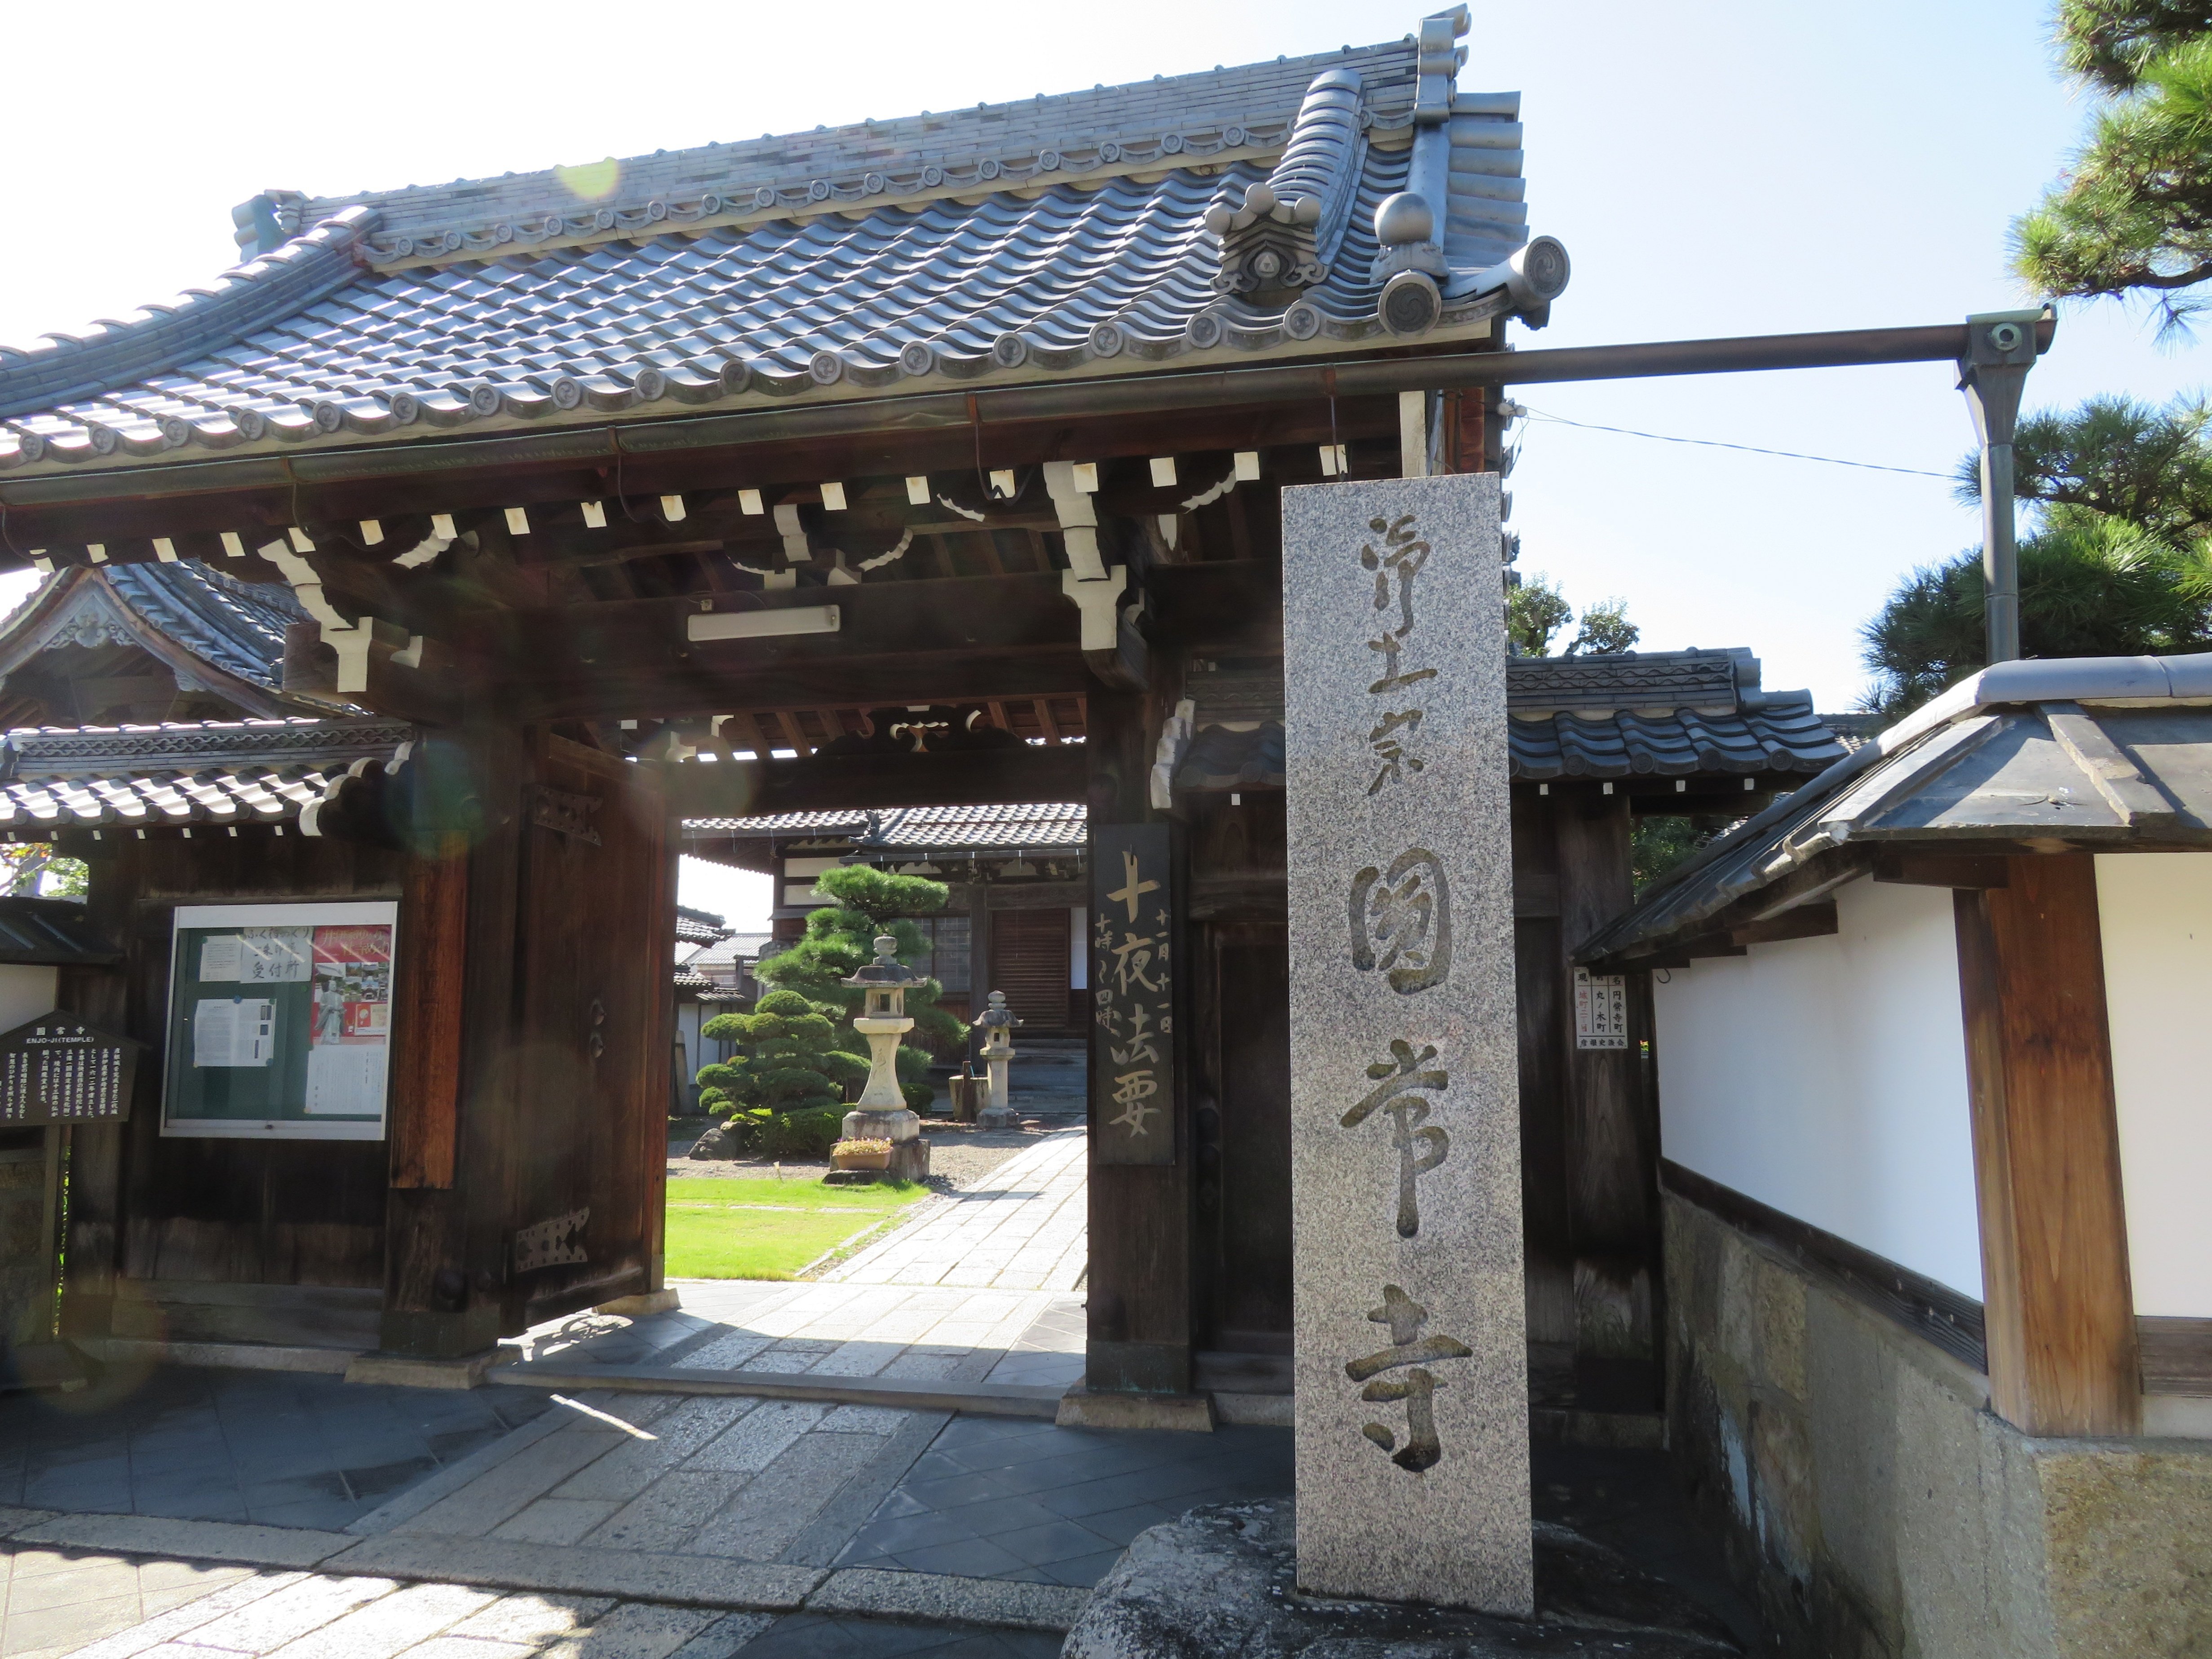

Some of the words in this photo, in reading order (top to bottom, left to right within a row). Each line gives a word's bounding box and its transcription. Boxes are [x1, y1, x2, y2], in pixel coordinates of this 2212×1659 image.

[1361, 513, 1439, 797] 浄土宗
[252, 960, 299, 979] 受付所
[1106, 851, 1162, 1138] 十夜法要
[1155, 909, 1173, 1034] 十一月十一日
[1578, 973, 1588, 982] 現
[1596, 991, 1606, 1032] 丸ノ木町
[1613, 991, 1624, 1033] 円常寺町
[1339, 845, 1473, 1475] 圓常寺
